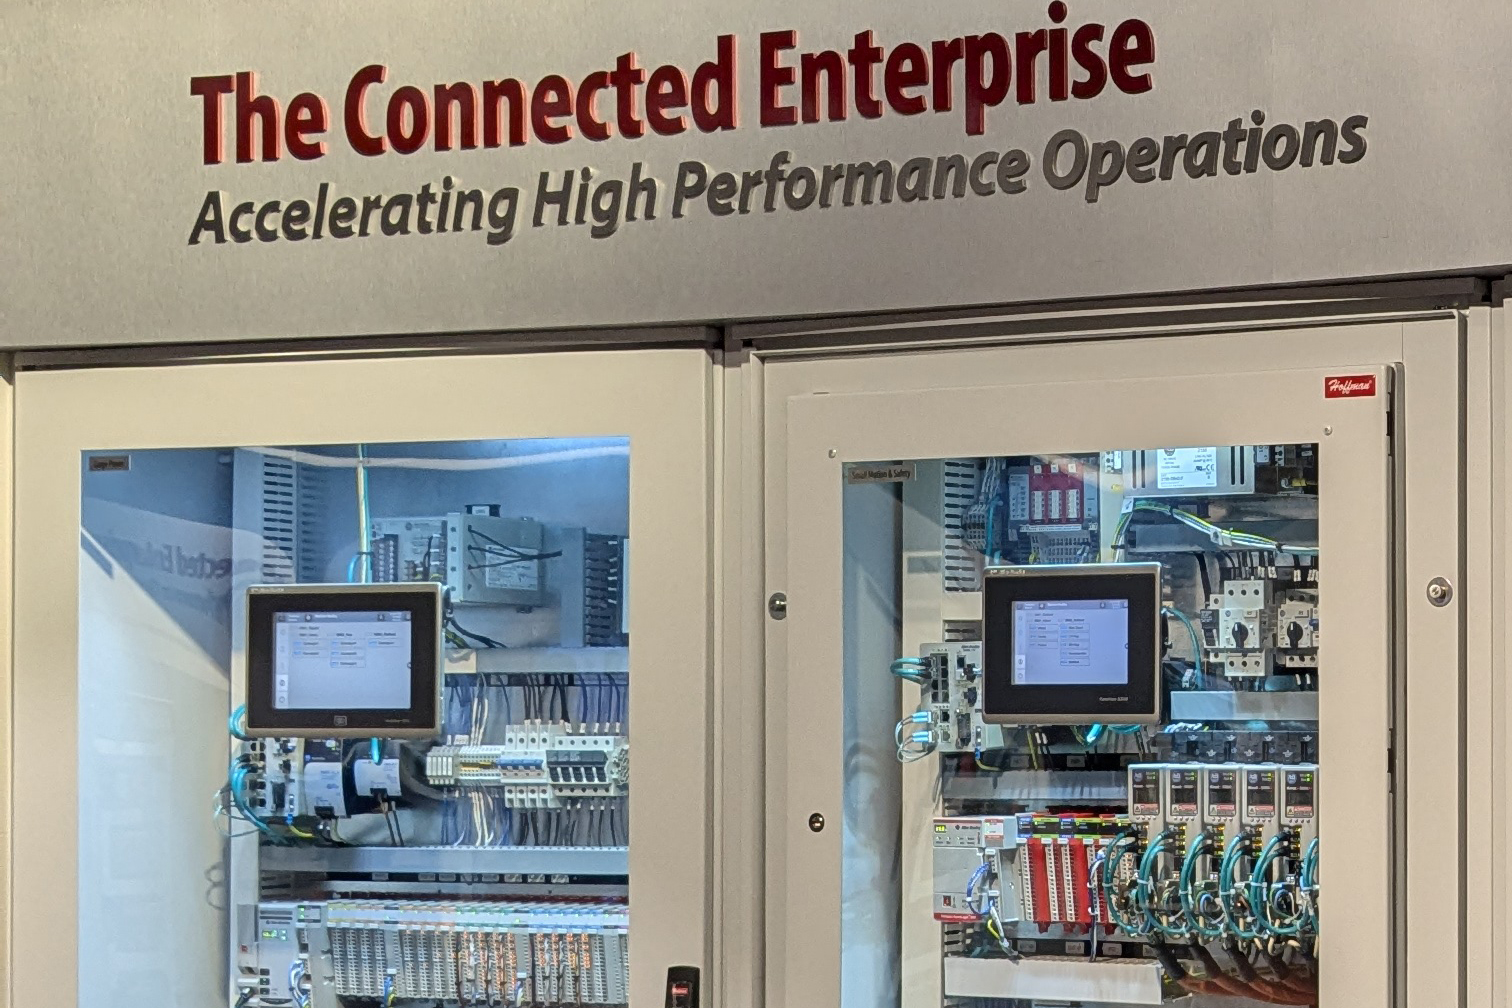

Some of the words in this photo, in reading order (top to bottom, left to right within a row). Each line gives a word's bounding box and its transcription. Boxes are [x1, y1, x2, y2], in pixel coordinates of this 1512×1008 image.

[189, 71, 329, 165] The
[343, 34, 740, 158] Connected
[759, 0, 1156, 136] Enterprise
[187, 175, 520, 245] Accelerating
[531, 163, 658, 239] High
[671, 147, 1030, 218] Performance
[1042, 109, 1368, 203] Operations
[868, 469, 888, 479] Motion
[893, 468, 911, 479] Safety
